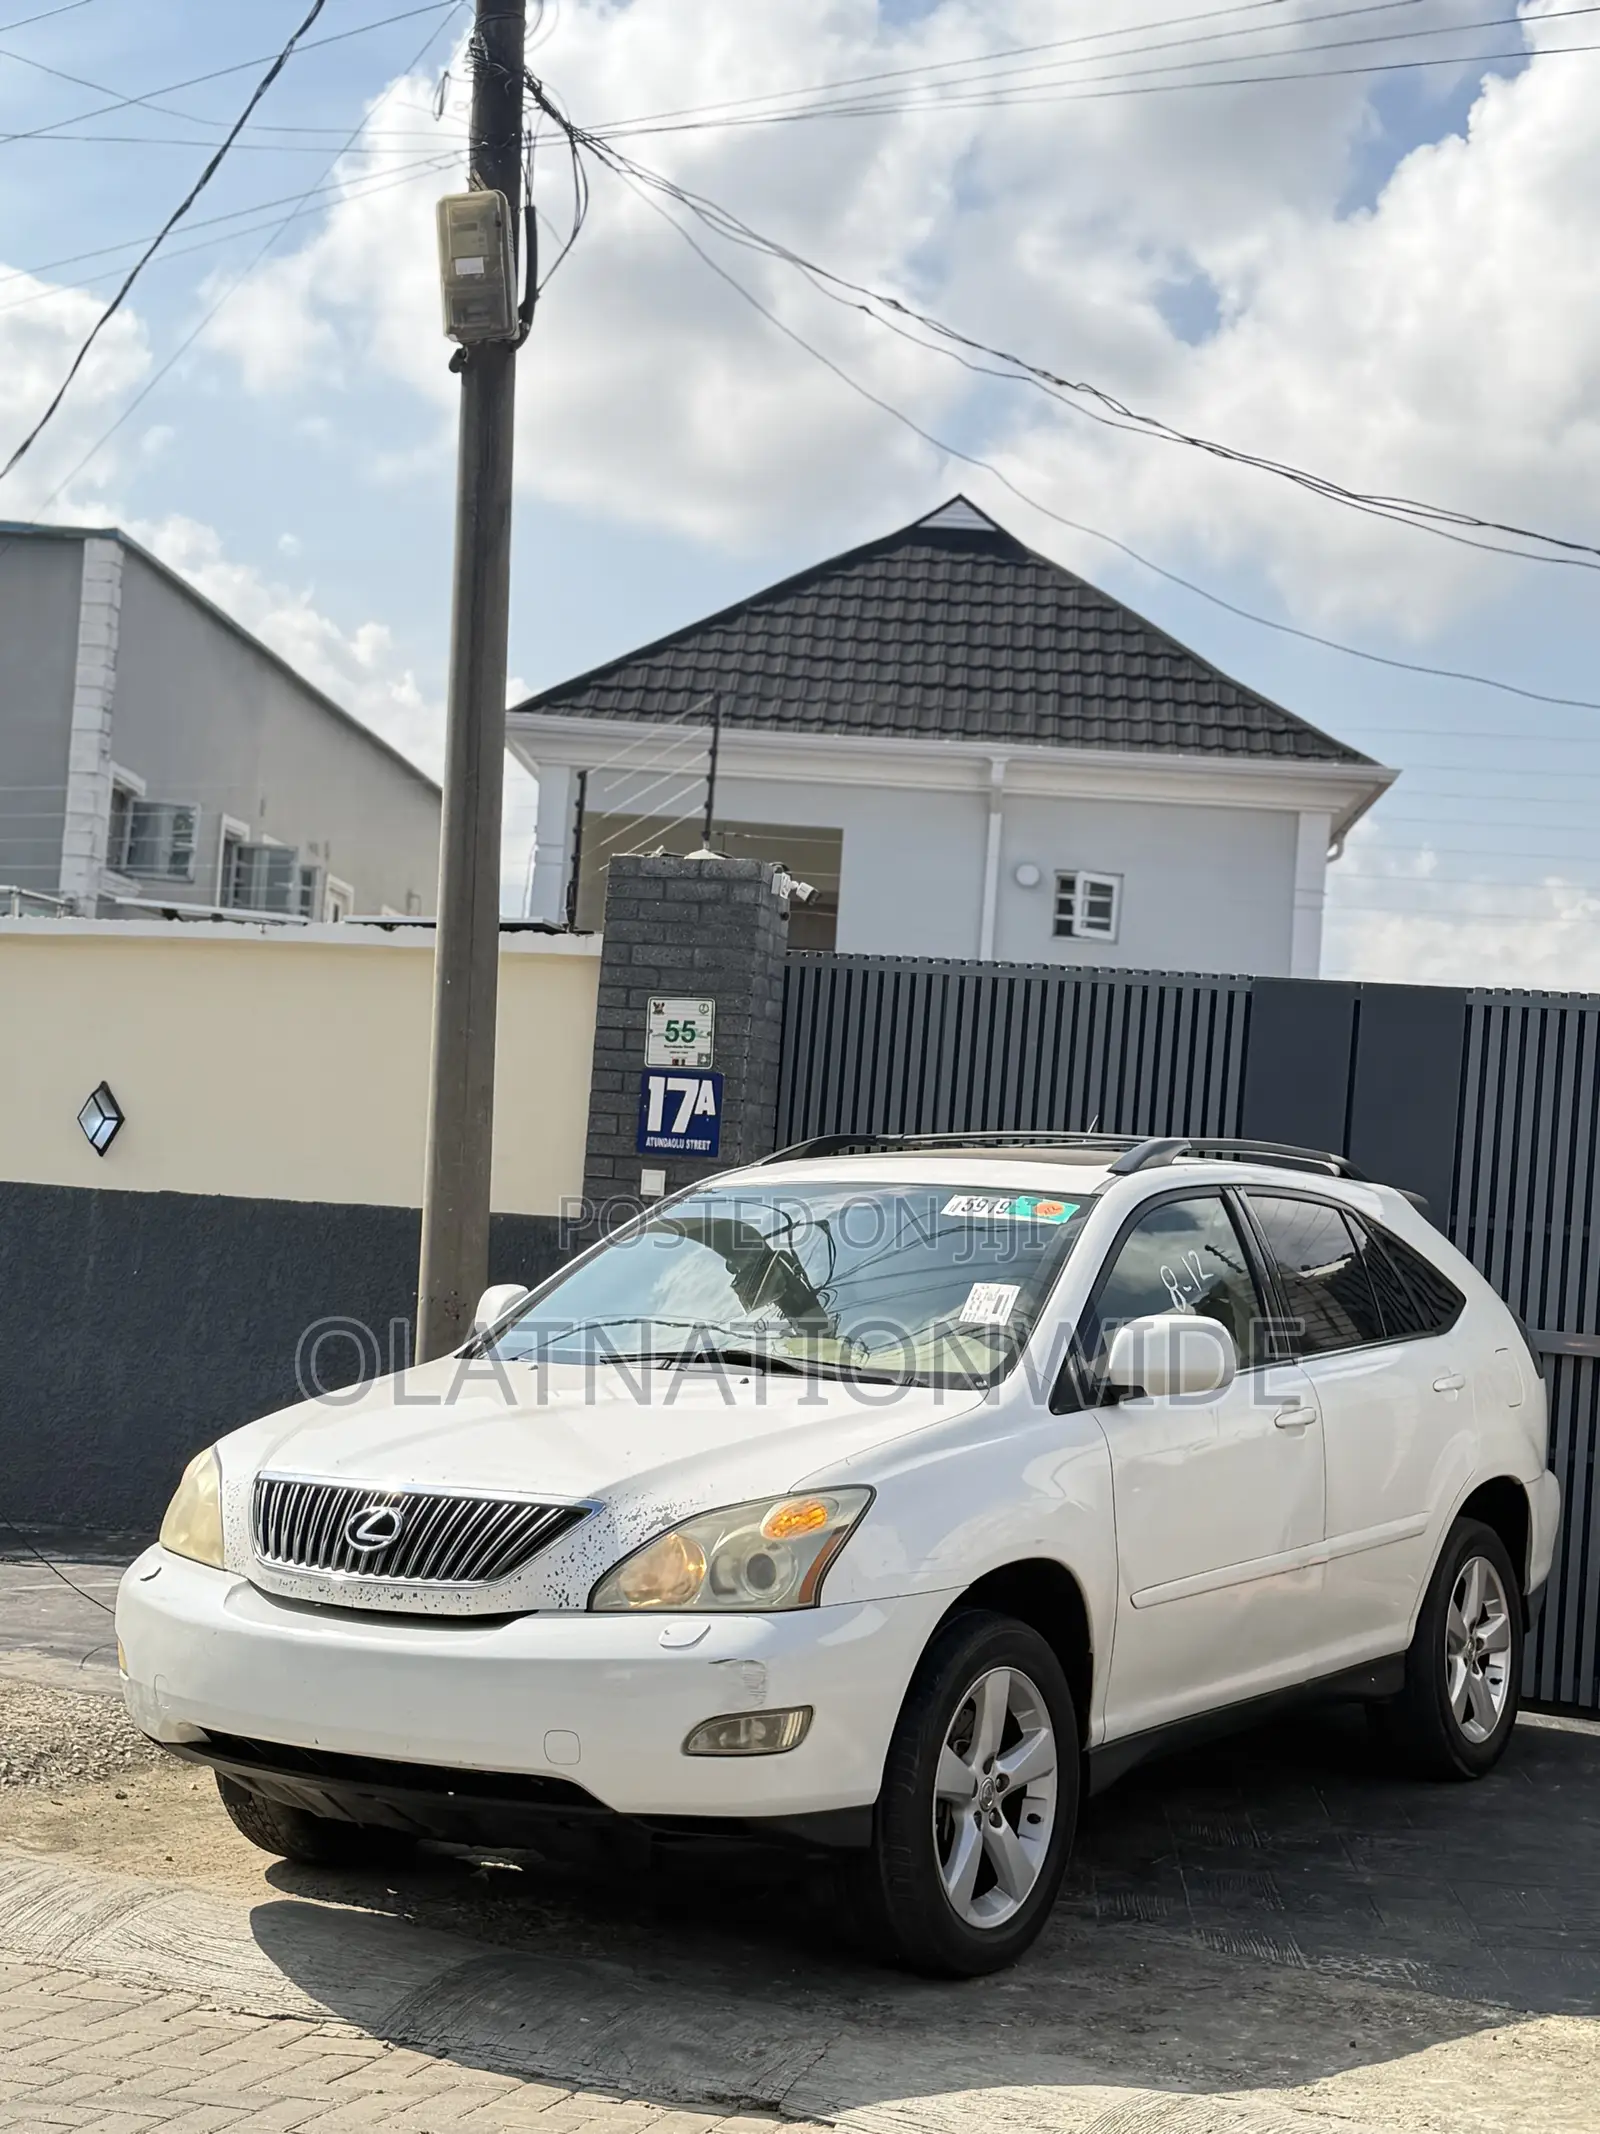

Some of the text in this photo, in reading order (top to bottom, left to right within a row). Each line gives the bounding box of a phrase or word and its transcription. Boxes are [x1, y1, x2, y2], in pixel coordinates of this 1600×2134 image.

[665, 1020, 696, 1044] 55
[647, 1076, 716, 1134] 17A
[686, 1138, 712, 1151] STREET
